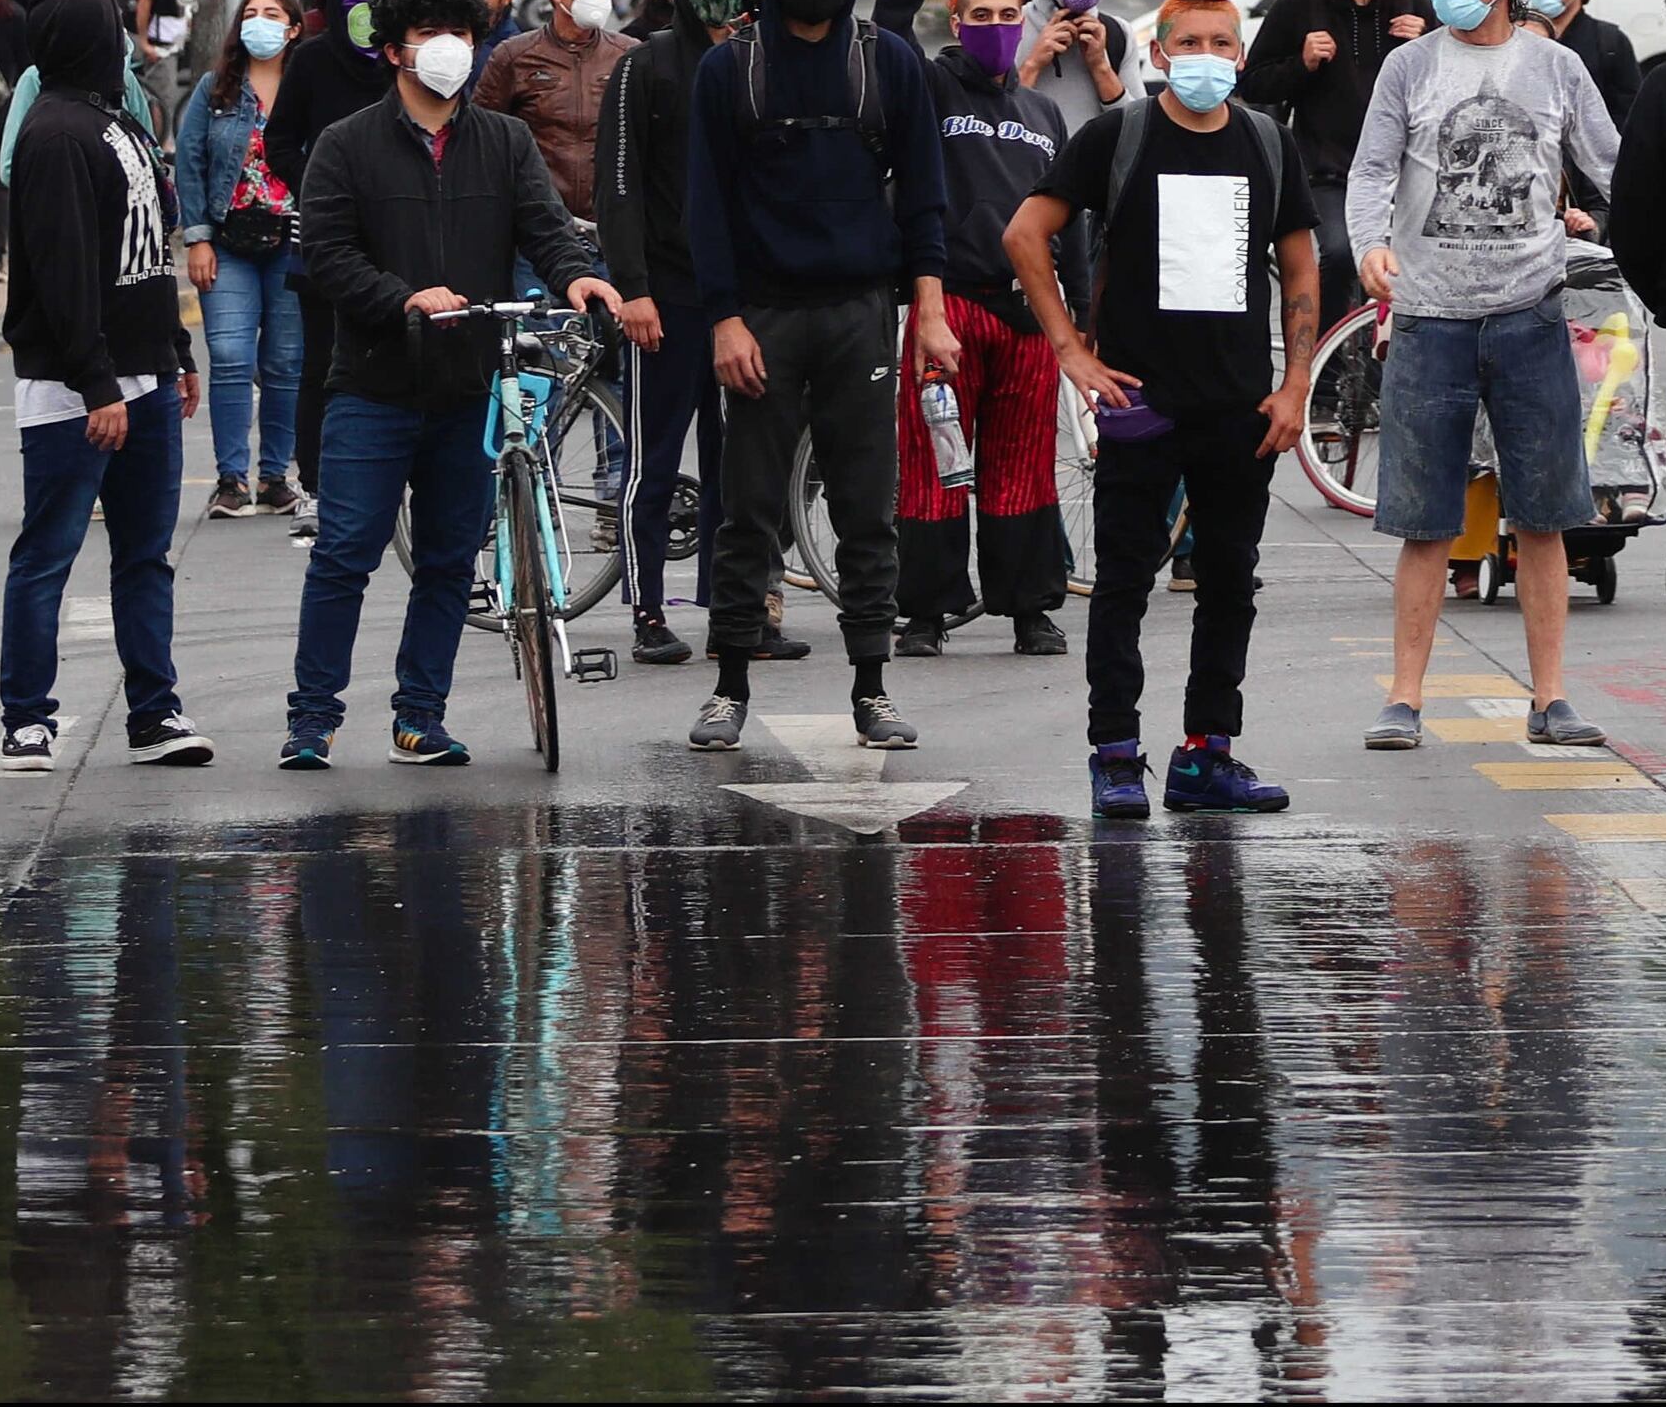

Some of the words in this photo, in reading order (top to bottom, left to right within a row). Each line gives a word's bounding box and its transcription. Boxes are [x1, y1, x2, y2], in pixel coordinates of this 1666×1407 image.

[941, 114, 995, 137] Blue
[1475, 118, 1504, 128] SINCE
[1234, 182, 1250, 232] KLEIN
[1235, 238, 1248, 305] CALVIN
